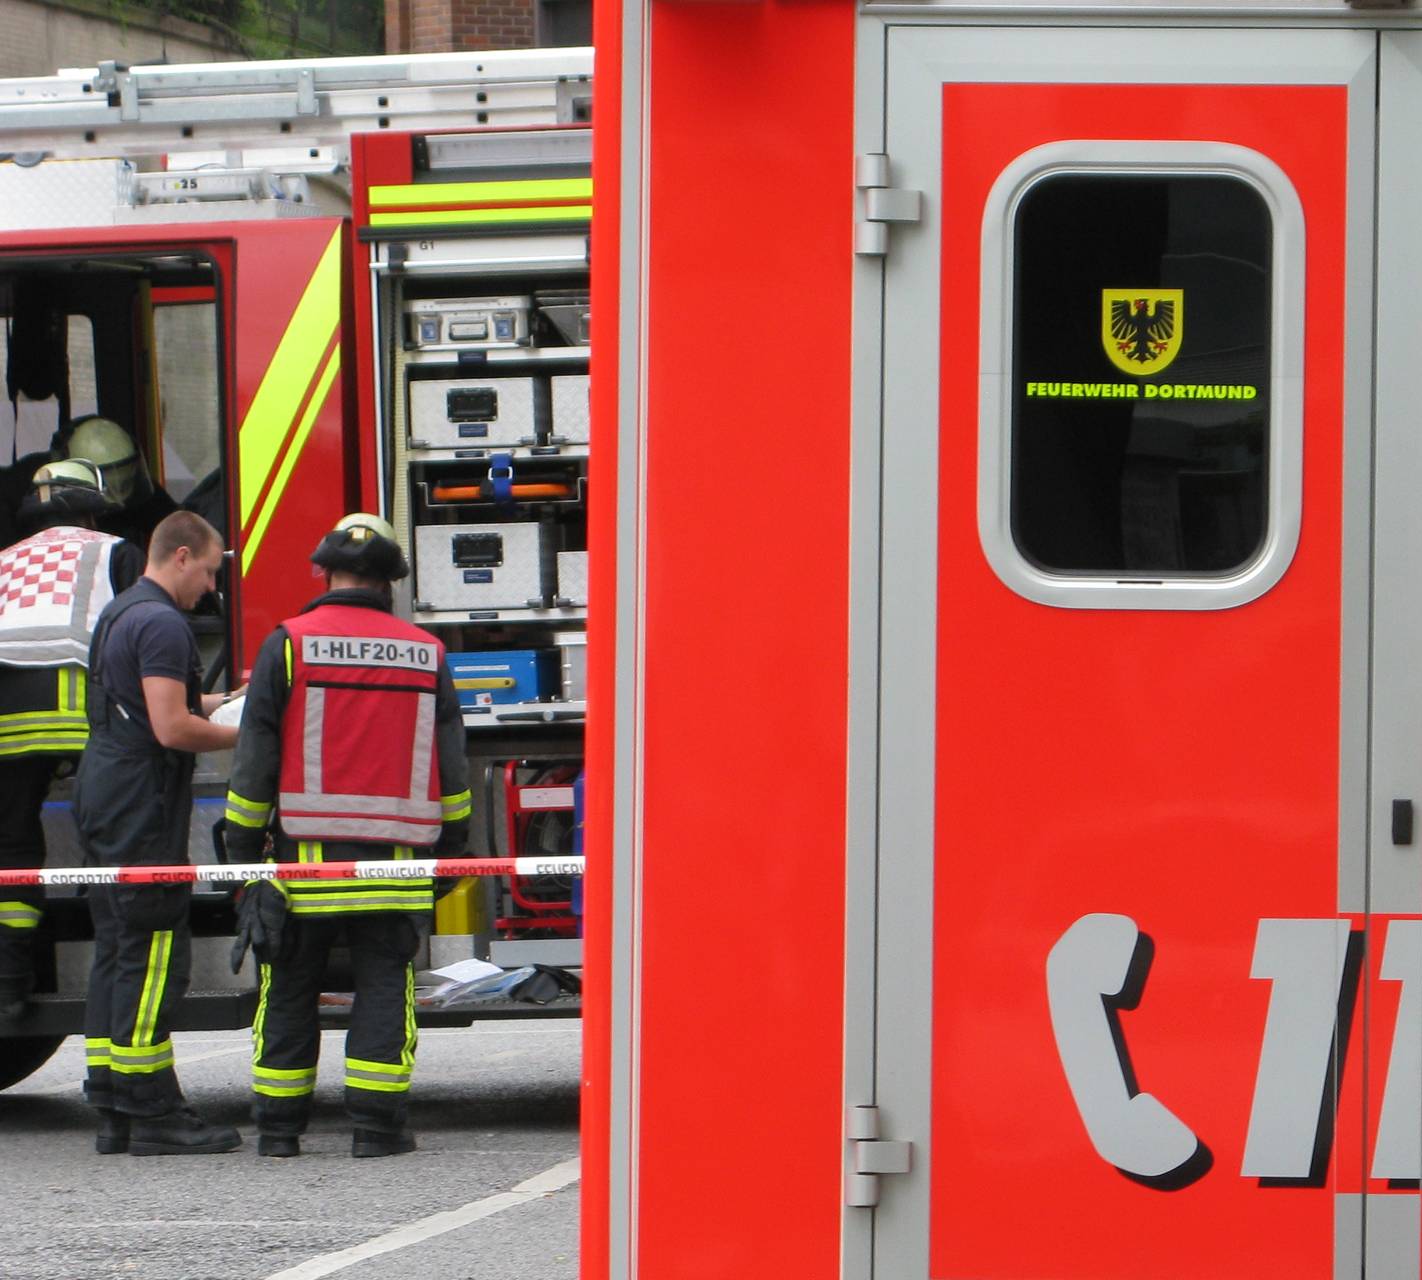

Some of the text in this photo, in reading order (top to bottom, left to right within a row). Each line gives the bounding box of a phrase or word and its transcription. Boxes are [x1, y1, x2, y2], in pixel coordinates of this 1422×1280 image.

[1026, 382, 1257, 399] FEUERWEHR DORTMUND
[309, 640, 430, 665] 1-HLF20-10
